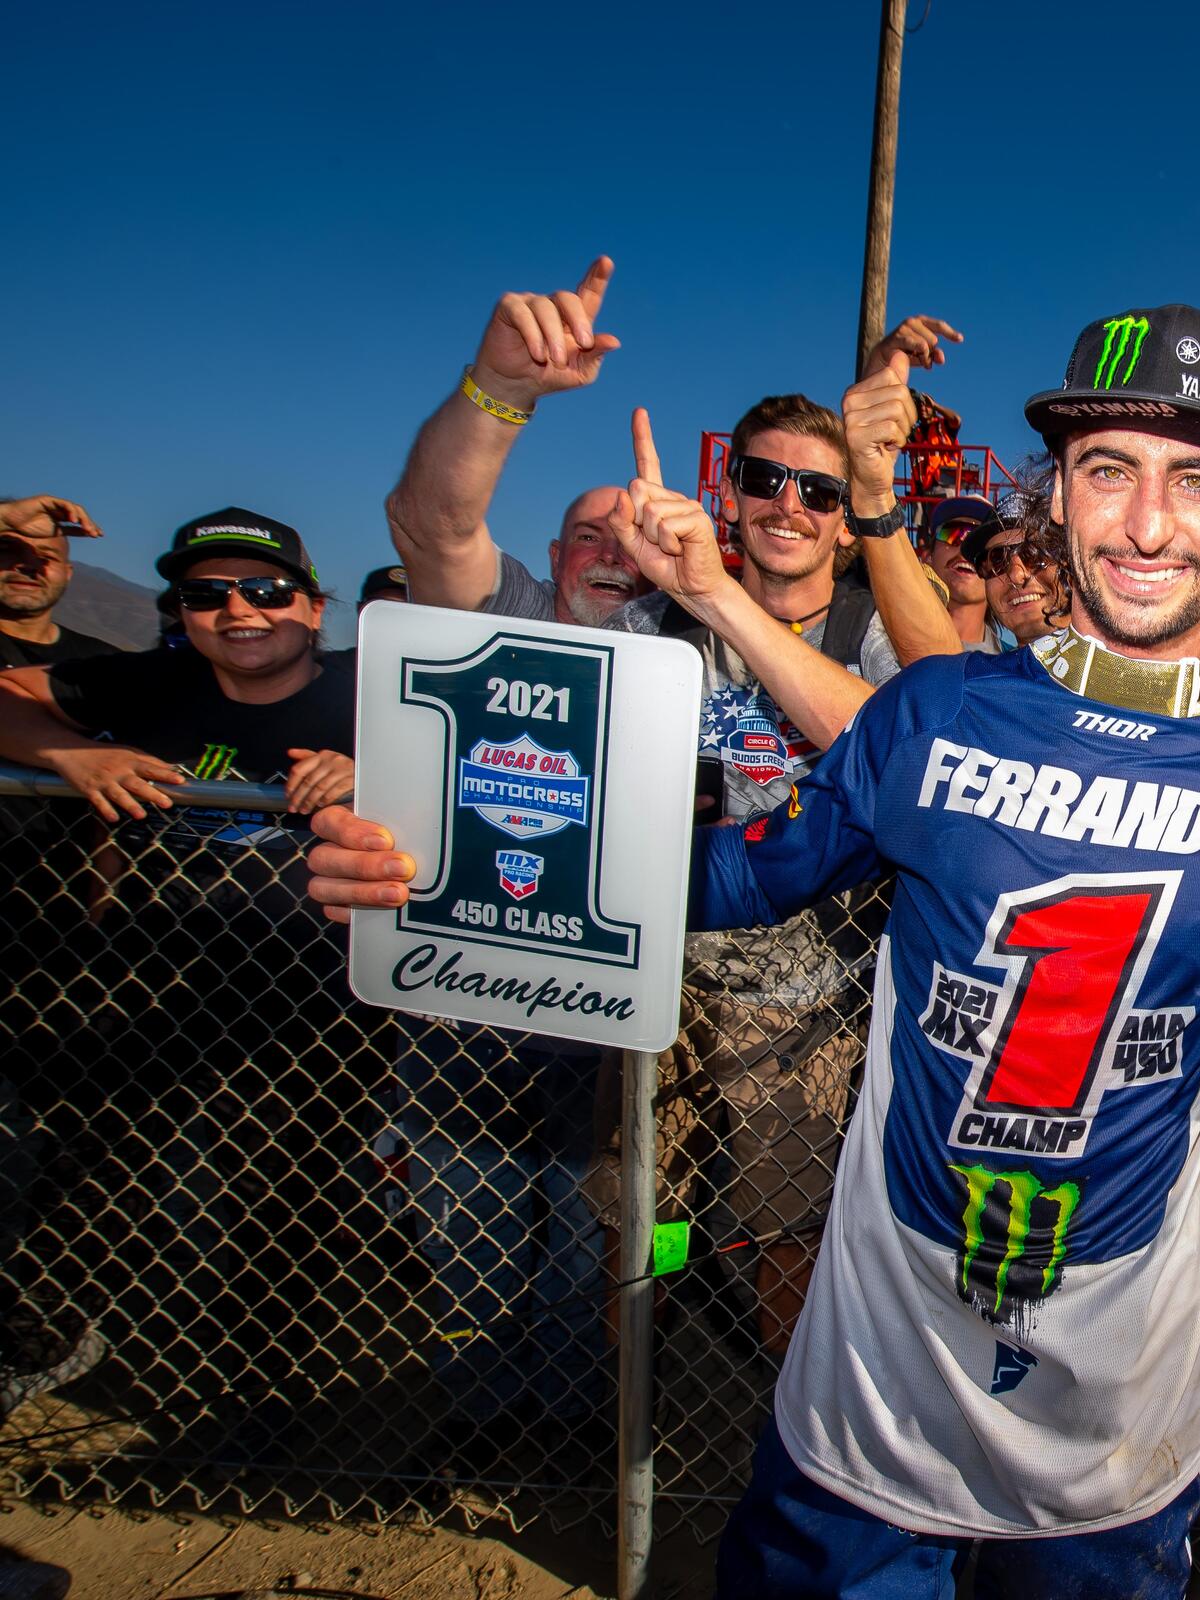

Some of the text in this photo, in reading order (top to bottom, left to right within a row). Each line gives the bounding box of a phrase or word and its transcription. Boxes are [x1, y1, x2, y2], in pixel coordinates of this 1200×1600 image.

[1073, 402, 1178, 414] YAMAHA
[195, 525, 271, 540] Kawasaki
[486, 677, 570, 723] 2021
[1072, 710, 1157, 742] THOR
[480, 747, 568, 776] LUCAS OIL
[731, 752, 785, 769] BUDDS CREEK
[739, 765, 781, 774] NATIONAL
[463, 776, 583, 807] MOTOCROSS
[507, 776, 540, 786] PRO
[463, 791, 583, 813] CHAMPIONSHIP
[501, 814, 528, 827] AMA
[451, 900, 584, 941] 450 CLASS
[391, 943, 636, 1021] Champion
[936, 972, 999, 1020] 2021
[973, 870, 1184, 1117] 1
[922, 998, 991, 1058] MX
[1116, 1013, 1186, 1043] AMA
[1111, 1040, 1179, 1083] 450
[957, 1113, 1087, 1153] CHAMP
